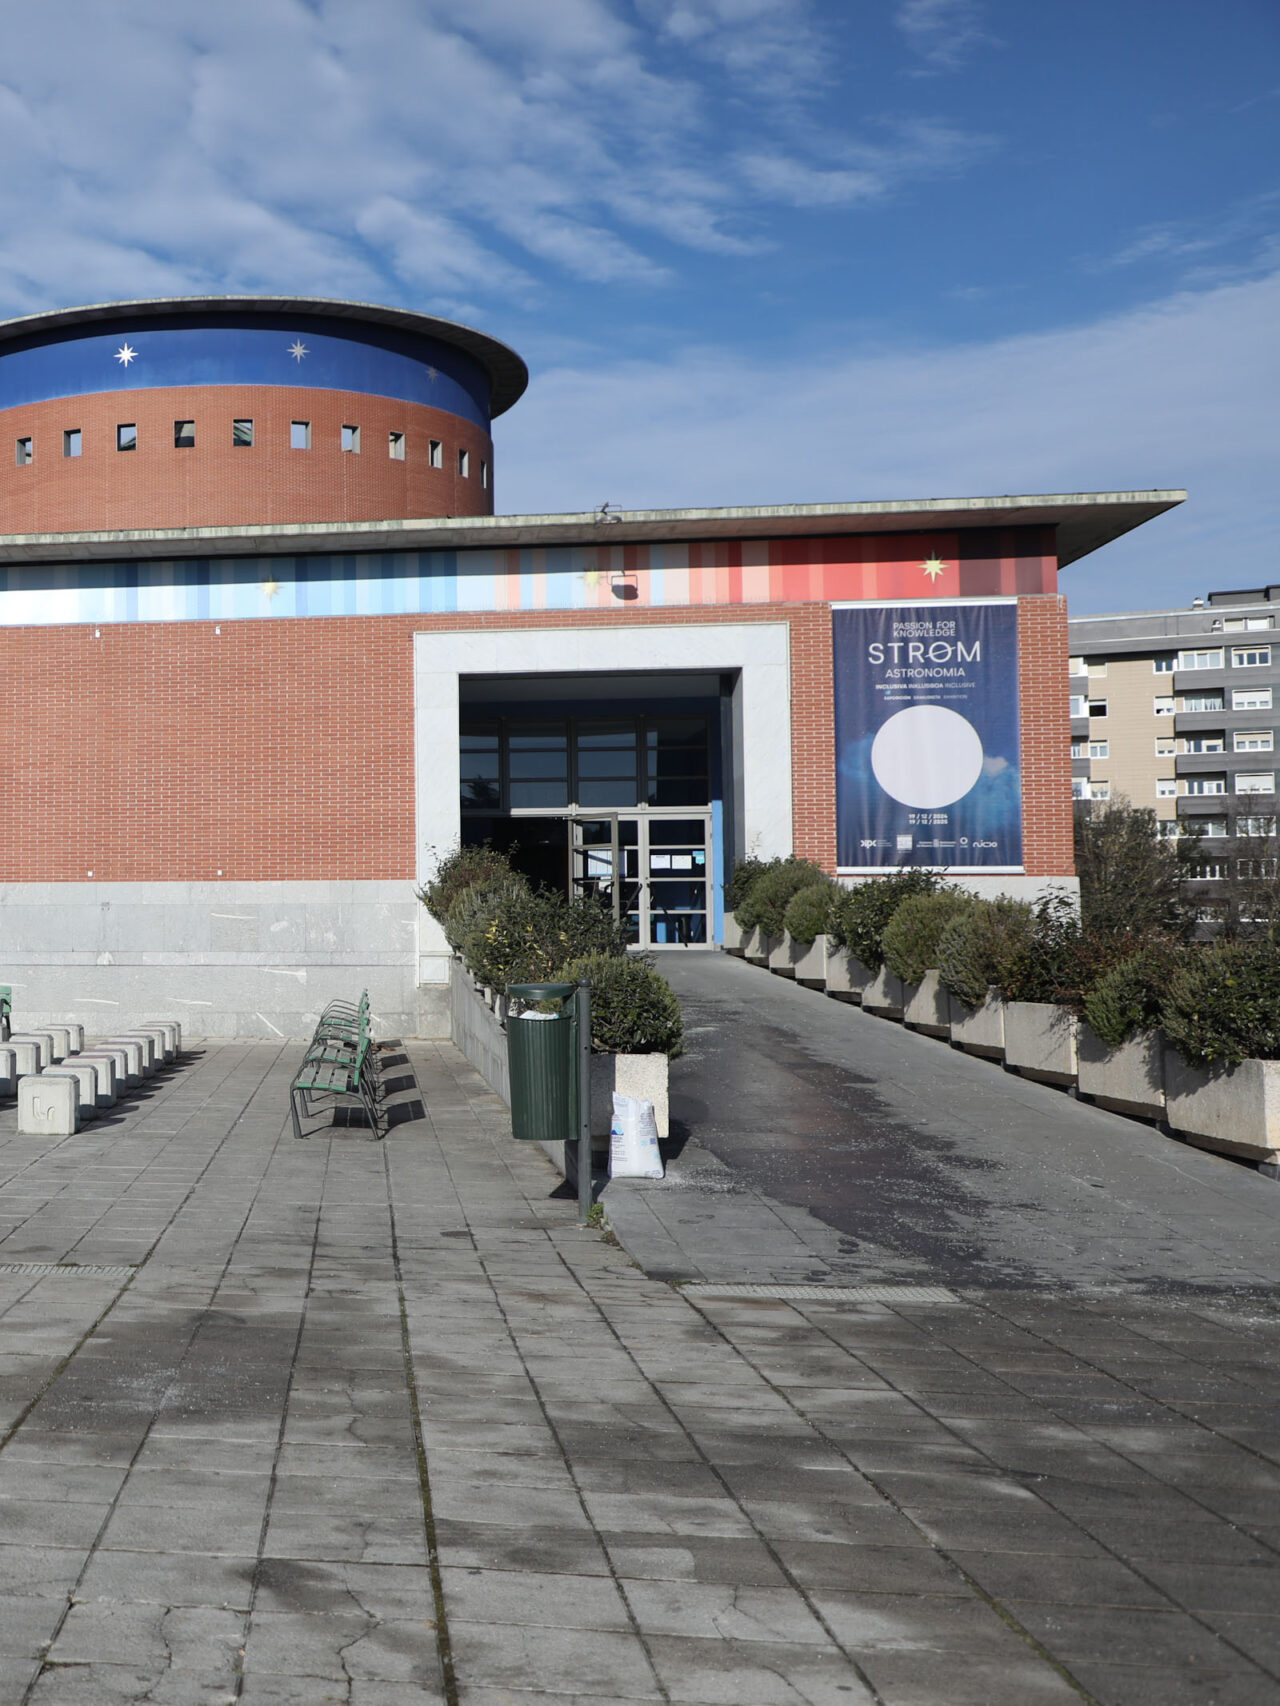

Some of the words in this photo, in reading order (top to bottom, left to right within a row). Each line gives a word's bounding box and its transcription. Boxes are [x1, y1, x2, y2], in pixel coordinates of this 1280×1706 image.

[893, 621, 932, 629] PASSION
[936, 620, 956, 629] FOR
[893, 629, 956, 637] KNOWLEDGE
[885, 667, 965, 678] ASTRONOMIA
